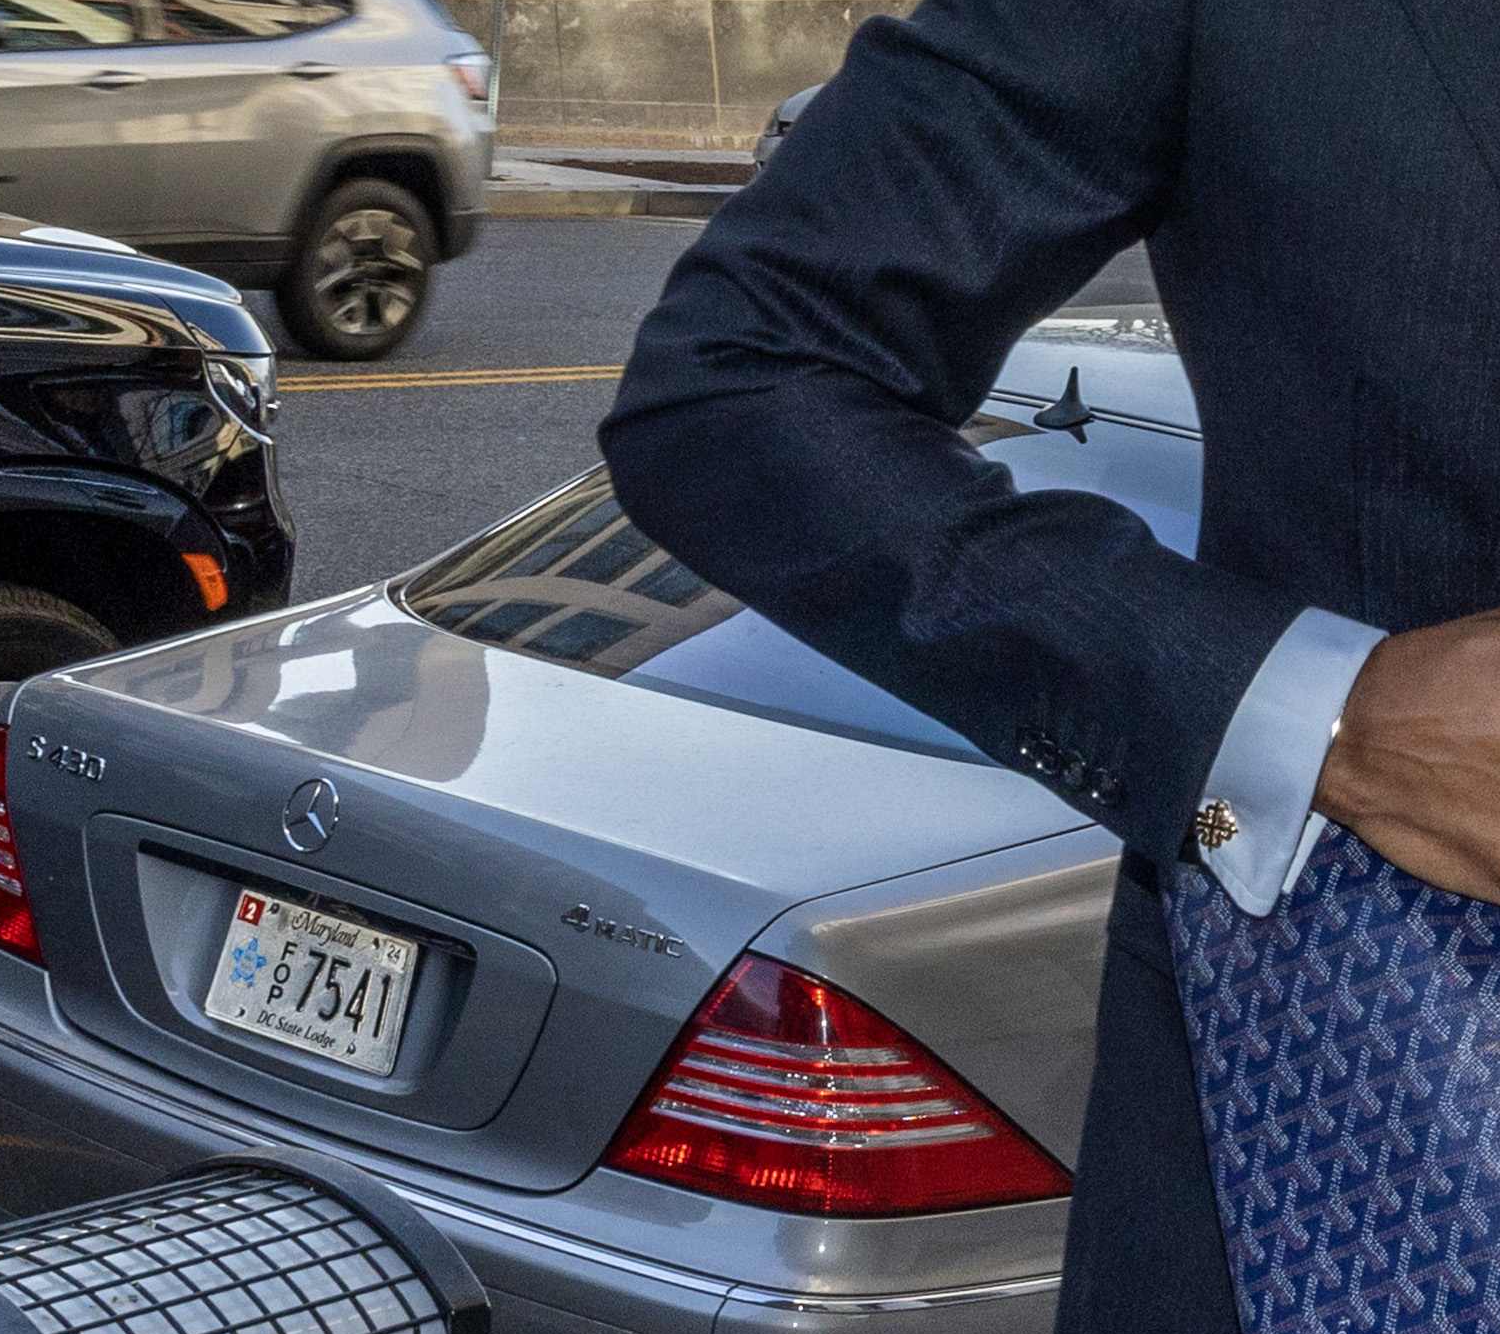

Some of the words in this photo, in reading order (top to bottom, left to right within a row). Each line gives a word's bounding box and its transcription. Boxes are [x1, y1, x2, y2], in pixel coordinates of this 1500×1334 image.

[26, 734, 47, 760] S
[49, 745, 106, 782] 430
[245, 901, 258, 920] 2
[291, 911, 361, 949] Maryland
[386, 943, 401, 965] 24
[296, 949, 393, 1039] 7541
[256, 1009, 274, 1027] DC
[274, 1017, 304, 1037] State
[303, 1027, 337, 1049] Lodge
